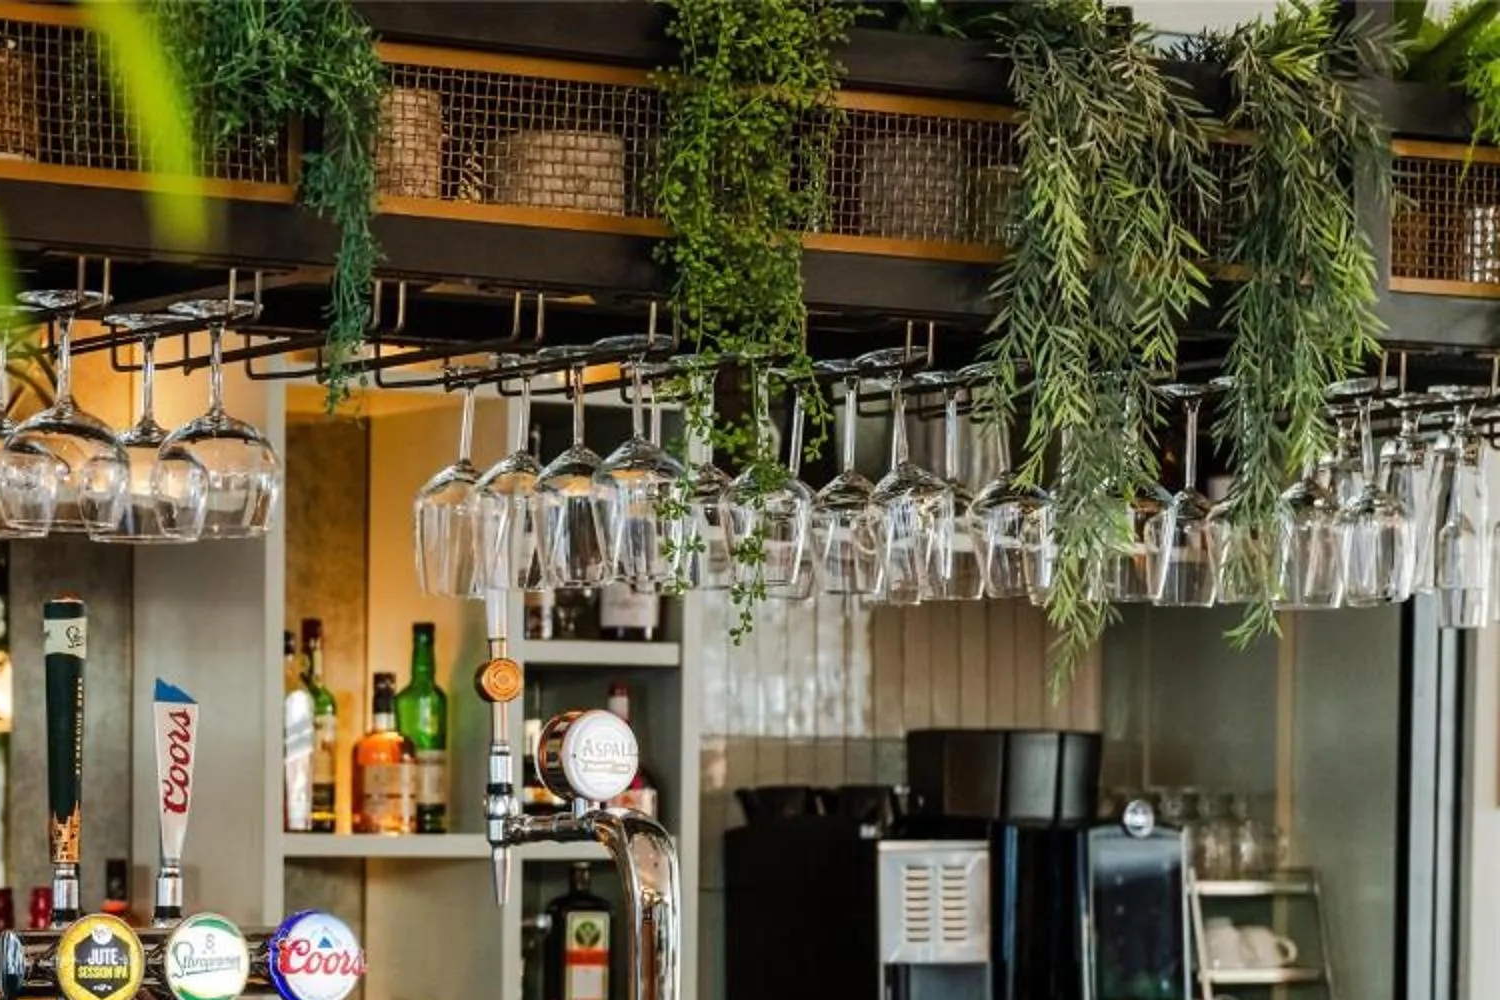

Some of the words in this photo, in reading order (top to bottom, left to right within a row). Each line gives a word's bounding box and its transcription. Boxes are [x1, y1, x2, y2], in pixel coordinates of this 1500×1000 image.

[162, 708, 191, 814] Coors
[87, 947, 119, 966] JUTE
[277, 938, 369, 975] Coors
[77, 966, 114, 979] SESSION
